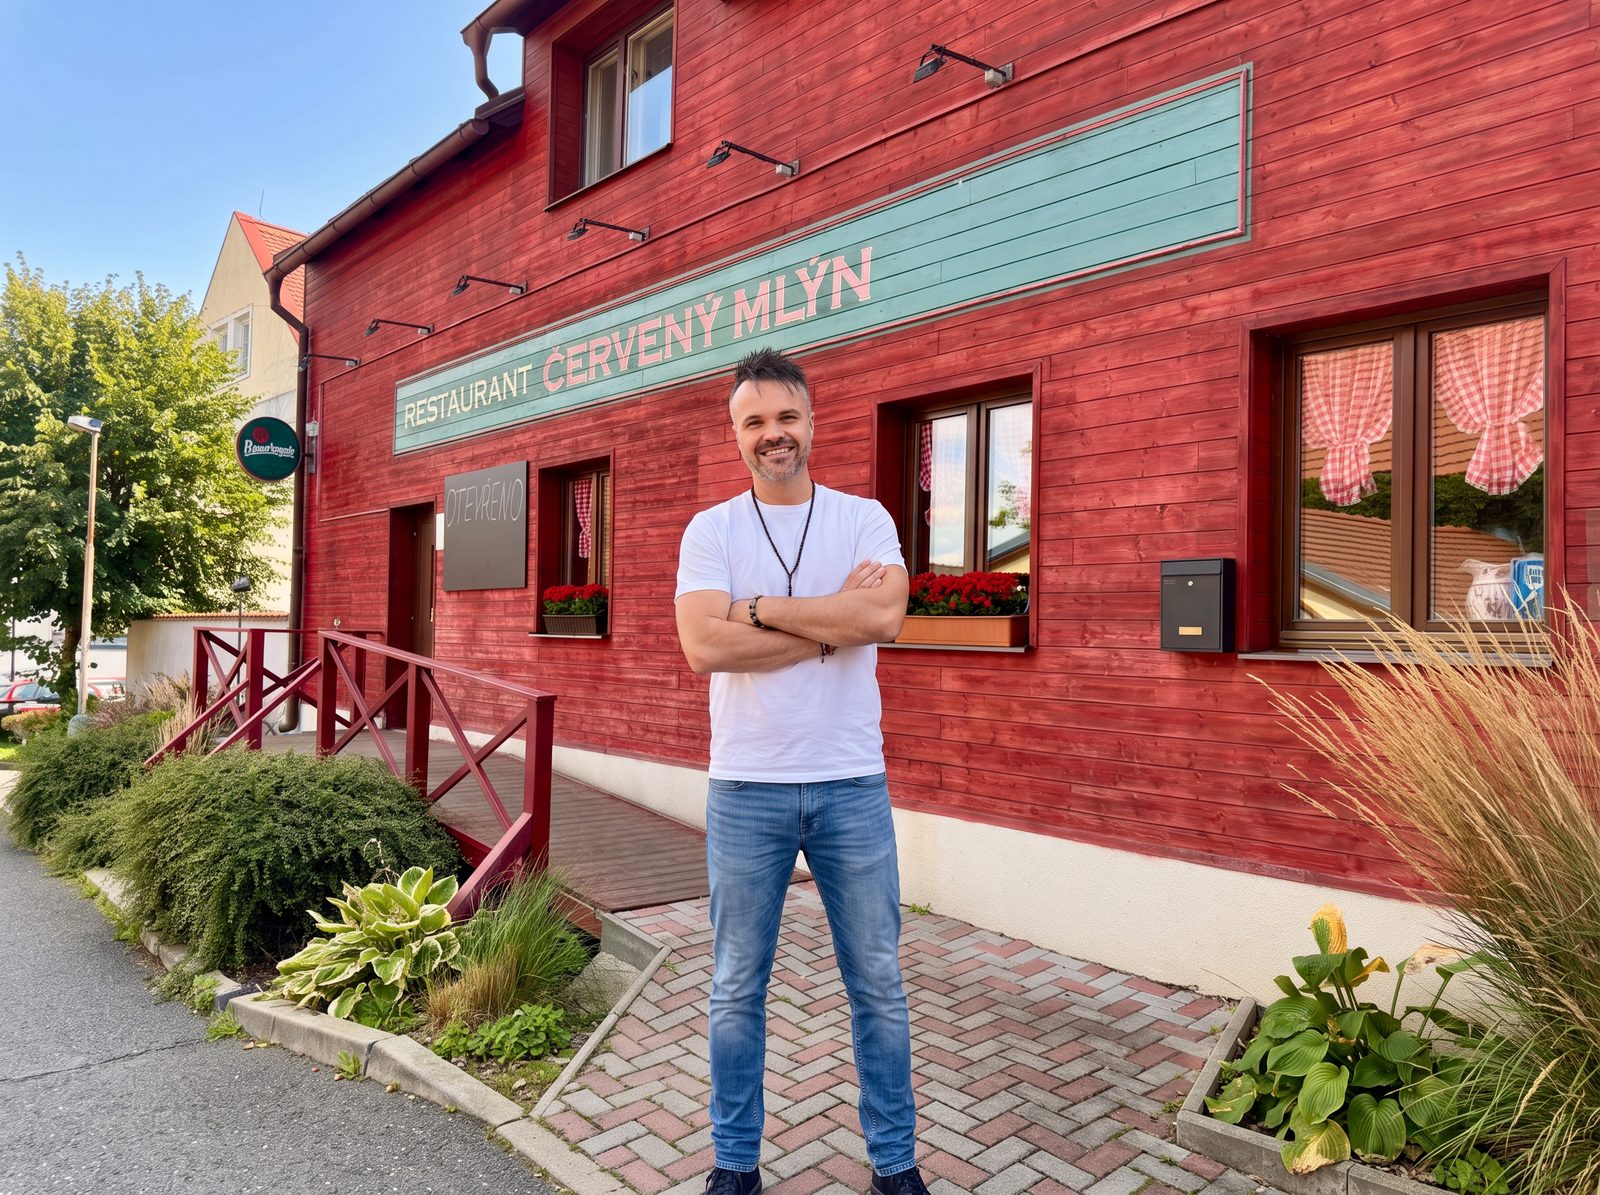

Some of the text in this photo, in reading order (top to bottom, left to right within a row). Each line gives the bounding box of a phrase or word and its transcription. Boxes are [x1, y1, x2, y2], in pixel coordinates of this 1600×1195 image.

[404, 246, 873, 429] RESTAURANT ČERVENÝ MLÝN
[447, 478, 524, 528] OTEVŘENO
